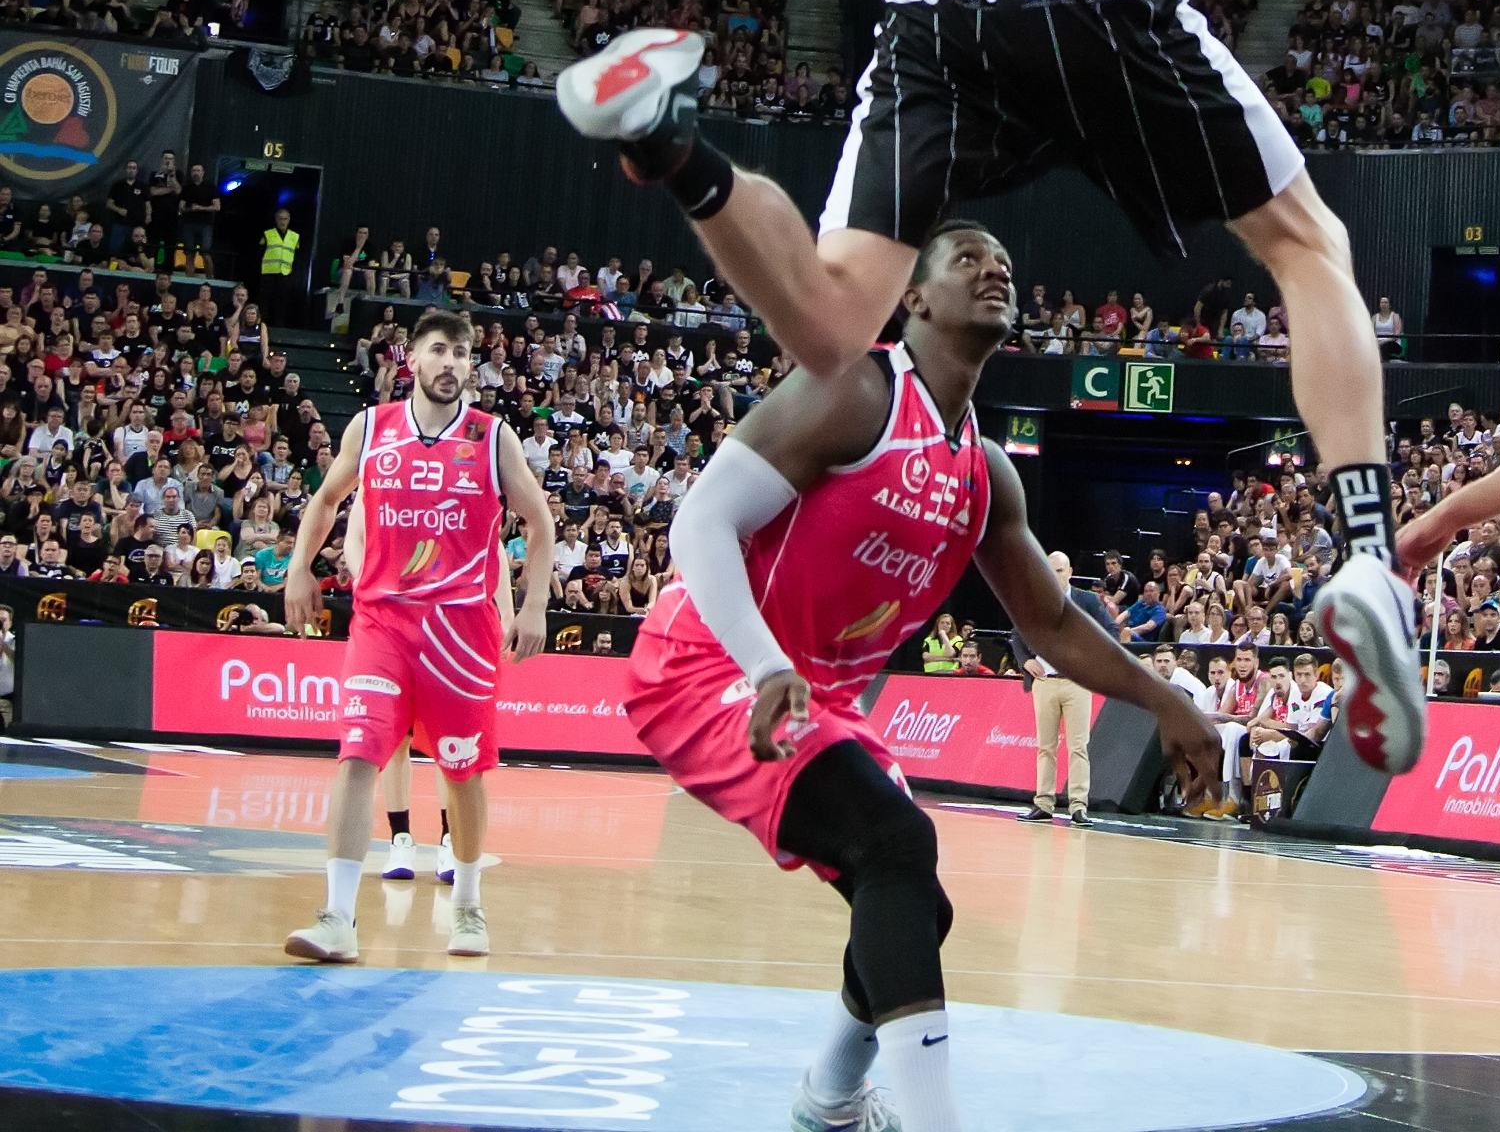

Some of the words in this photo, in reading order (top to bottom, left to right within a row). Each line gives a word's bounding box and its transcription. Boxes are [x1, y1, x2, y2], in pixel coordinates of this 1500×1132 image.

[263, 141, 284, 159] 05
[1465, 226, 1482, 241] 03
[1084, 367, 1110, 397] C
[370, 478, 402, 489] ALSA
[410, 460, 444, 491] 23
[378, 500, 467, 535] iberojet
[872, 487, 921, 520] ALSA
[221, 658, 340, 705] Palm
[547, 702, 588, 715] cerca
[593, 698, 612, 716] de
[883, 699, 961, 743] Palmer
[389, 980, 750, 1121] endesa
